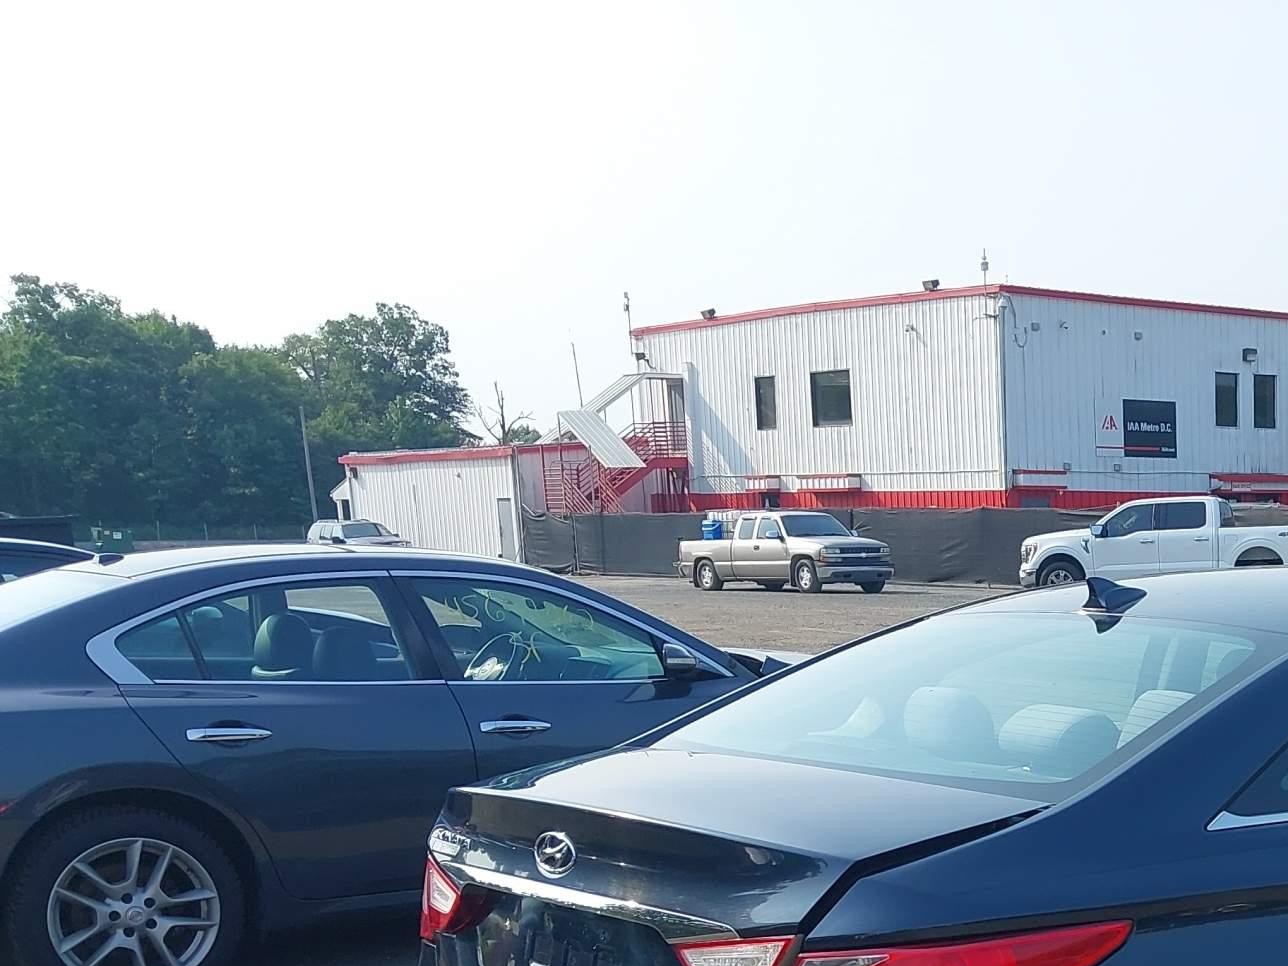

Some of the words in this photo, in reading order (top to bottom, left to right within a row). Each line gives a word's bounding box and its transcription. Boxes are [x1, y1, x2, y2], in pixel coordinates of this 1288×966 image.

[1127, 421, 1140, 431] IAA
[1140, 422, 1160, 432] Metro
[1160, 423, 1173, 433] D.C.
